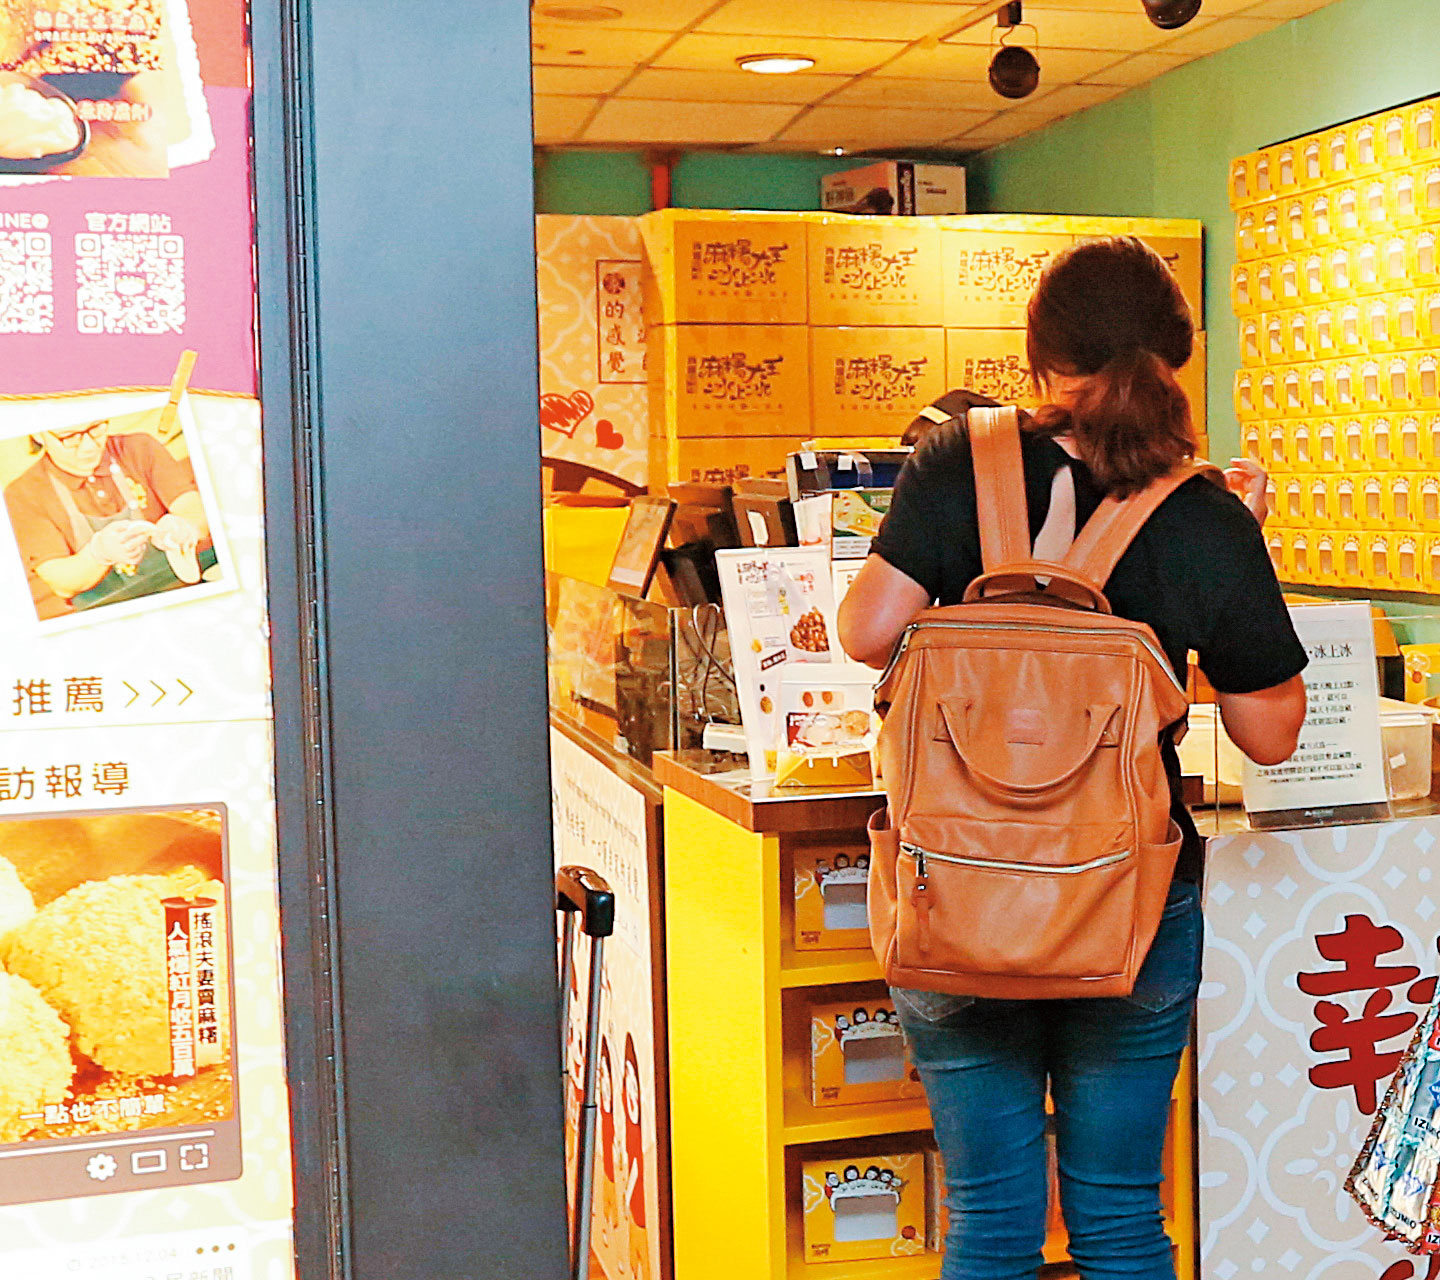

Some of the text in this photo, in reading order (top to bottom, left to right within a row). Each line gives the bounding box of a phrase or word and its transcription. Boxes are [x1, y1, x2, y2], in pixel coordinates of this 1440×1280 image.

[85, 212, 172, 234] 官方網站
[20, 1094, 166, 1126] 一點也不簡單
